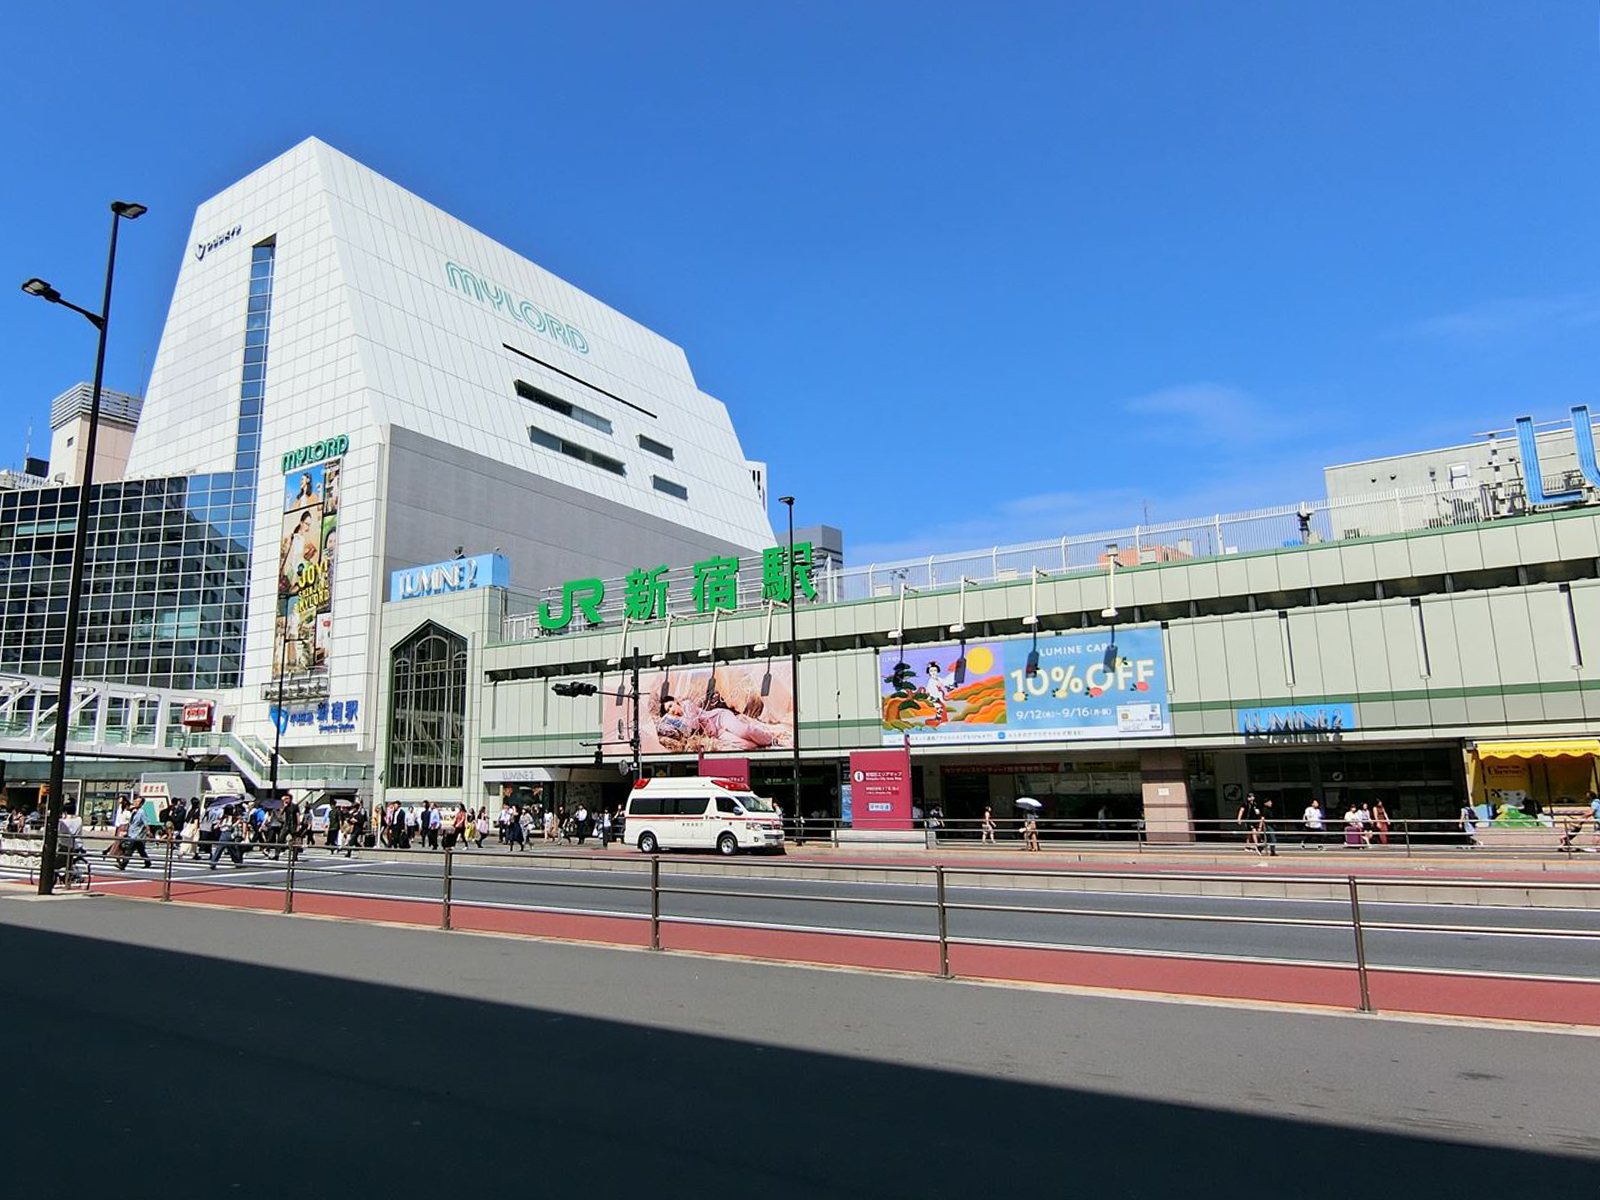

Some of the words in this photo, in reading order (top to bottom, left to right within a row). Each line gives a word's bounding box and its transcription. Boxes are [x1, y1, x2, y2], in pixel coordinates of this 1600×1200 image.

[445, 261, 589, 354] MYLORD
[282, 434, 348, 472] MYLORD
[1040, 645, 1082, 657] LUMINE
